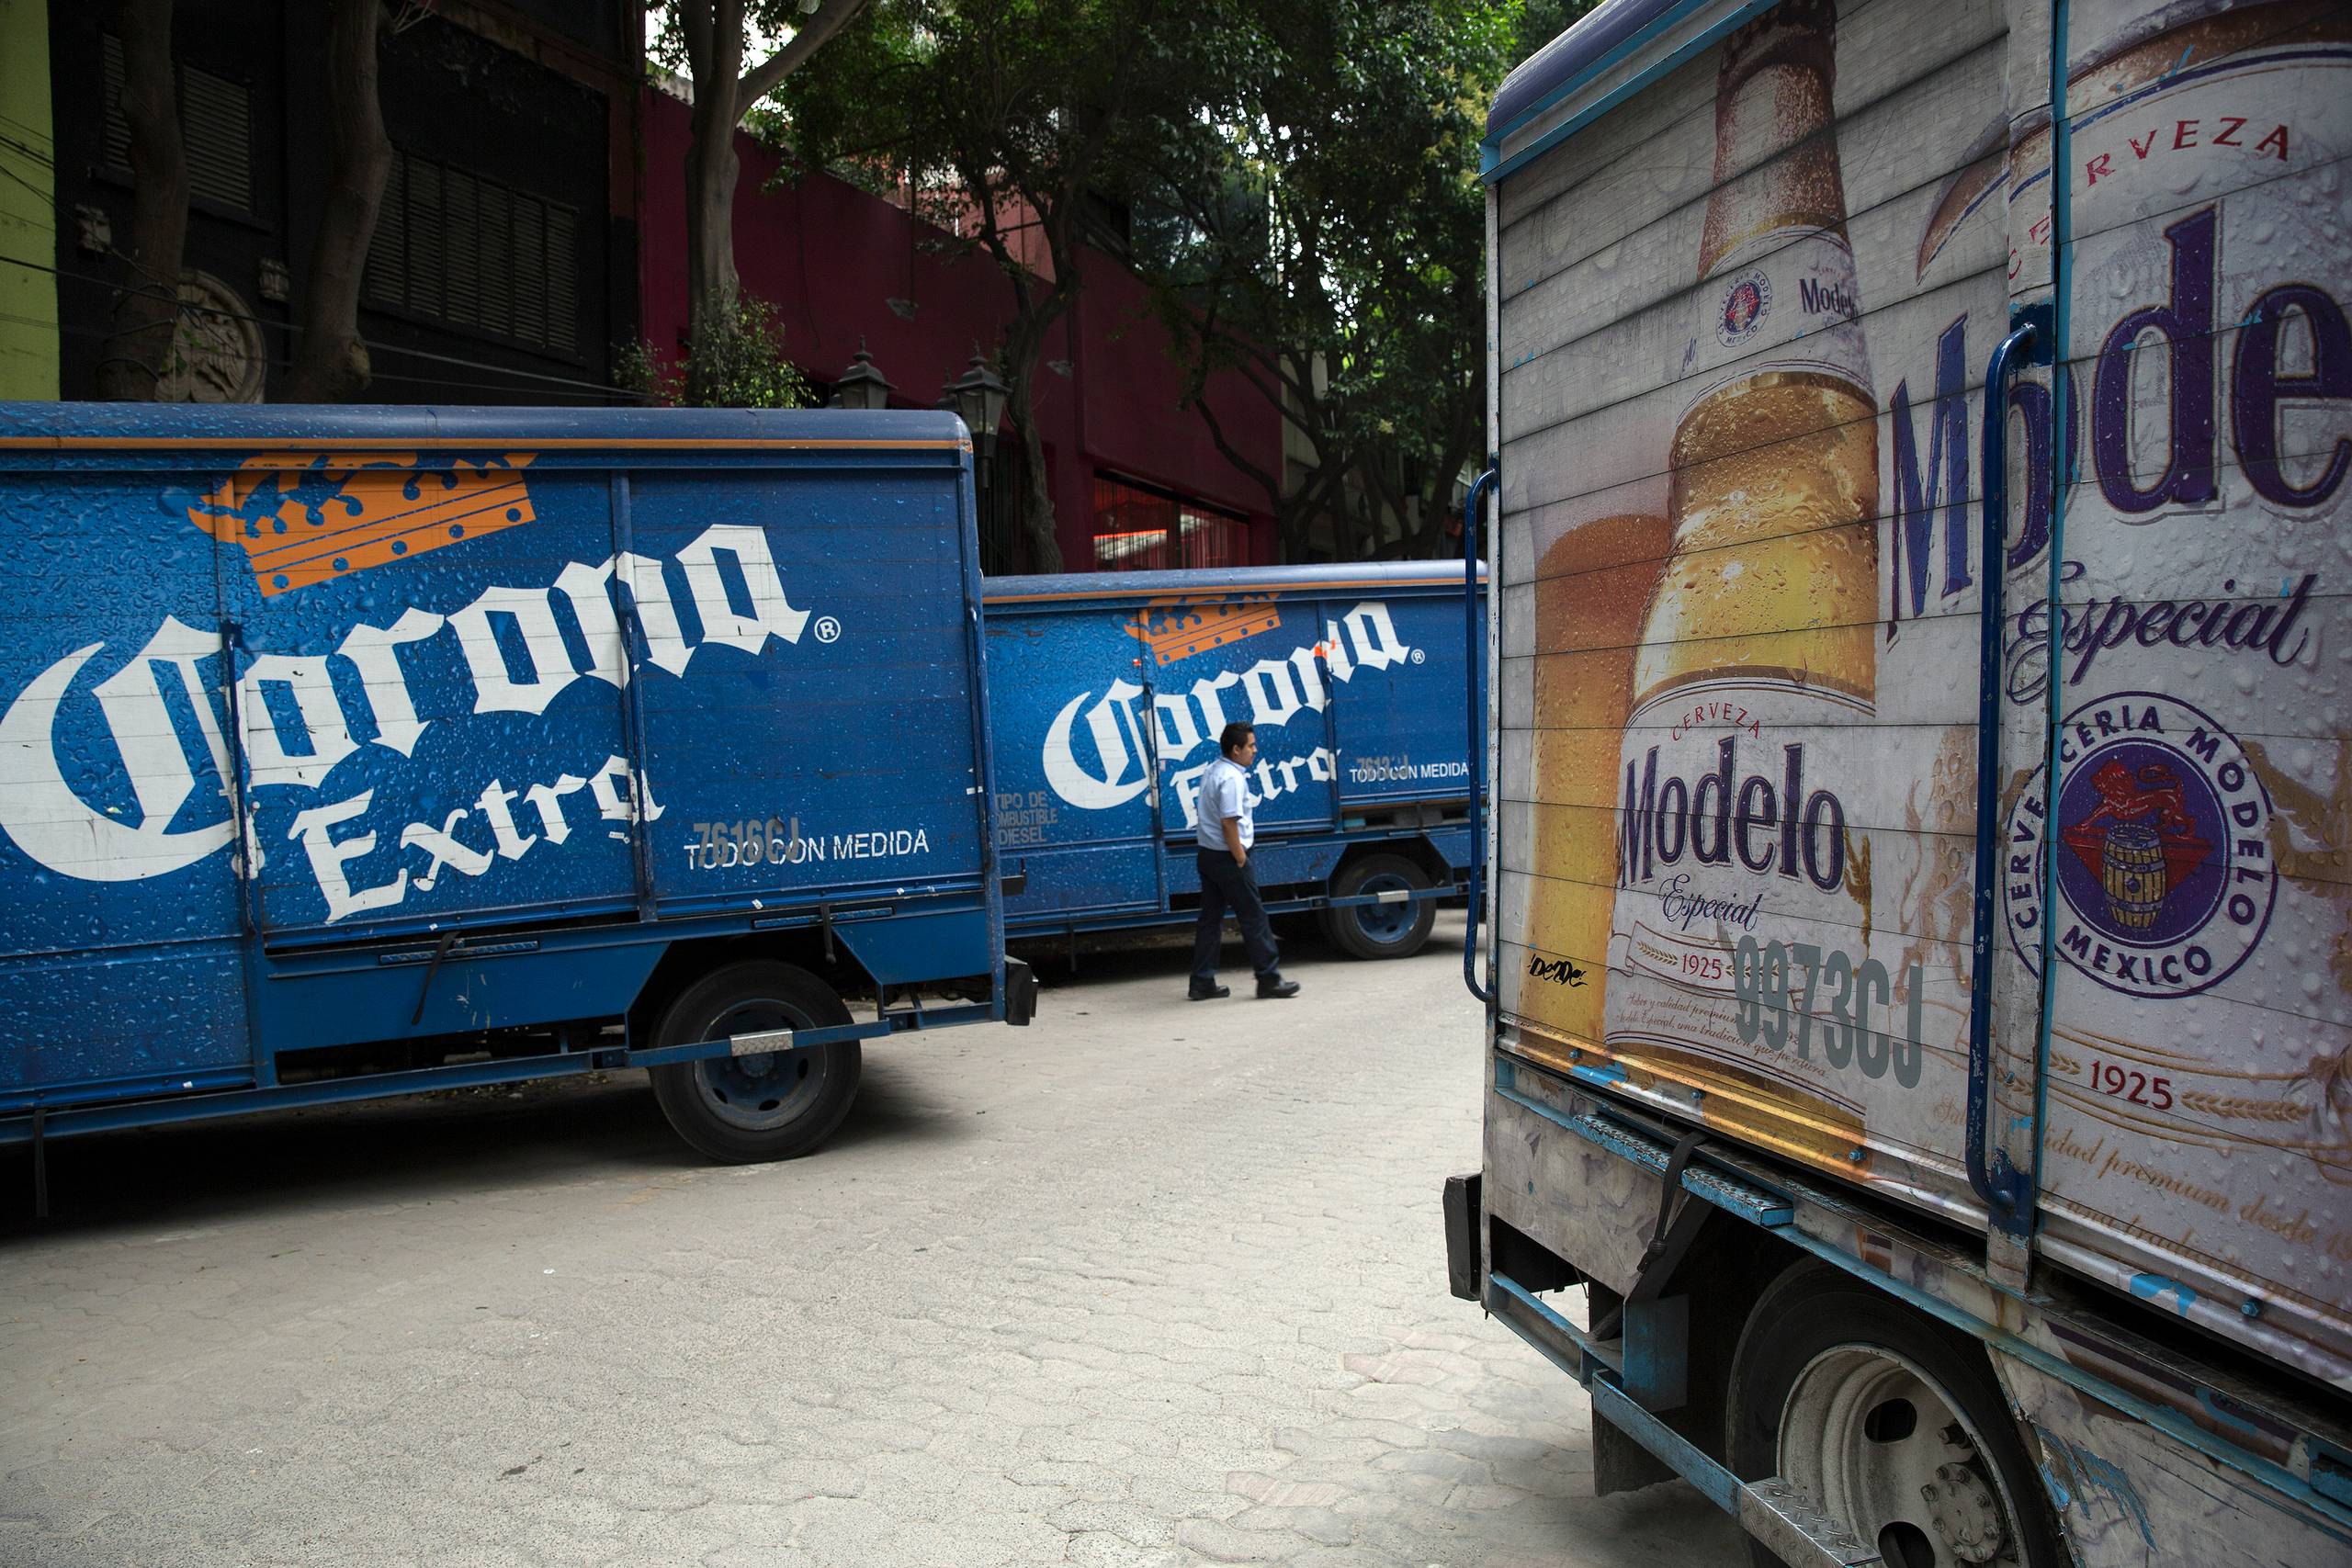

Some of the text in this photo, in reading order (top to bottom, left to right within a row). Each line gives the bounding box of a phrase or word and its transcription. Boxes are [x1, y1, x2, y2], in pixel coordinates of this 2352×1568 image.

[0, 524, 812, 882] Corona
[1042, 602, 1410, 810] Corona
[1671, 703, 1761, 741] CERVEZA
[1420, 761, 1469, 779] MEDIDA
[1029, 791, 1047, 808] DE
[1619, 734, 1846, 892] Modelo
[2184, 726, 2266, 926] MODELO
[288, 753, 666, 925] Extra
[833, 829, 930, 861] MEDIDA
[999, 825, 1046, 846] DIESEL
[1658, 873, 1764, 931] Especial
[1681, 952, 1722, 981] 1925
[2062, 924, 2213, 986] MEXICO
[1735, 933, 1923, 1090] 9973CJ
[2090, 1059, 2174, 1111] 1925
